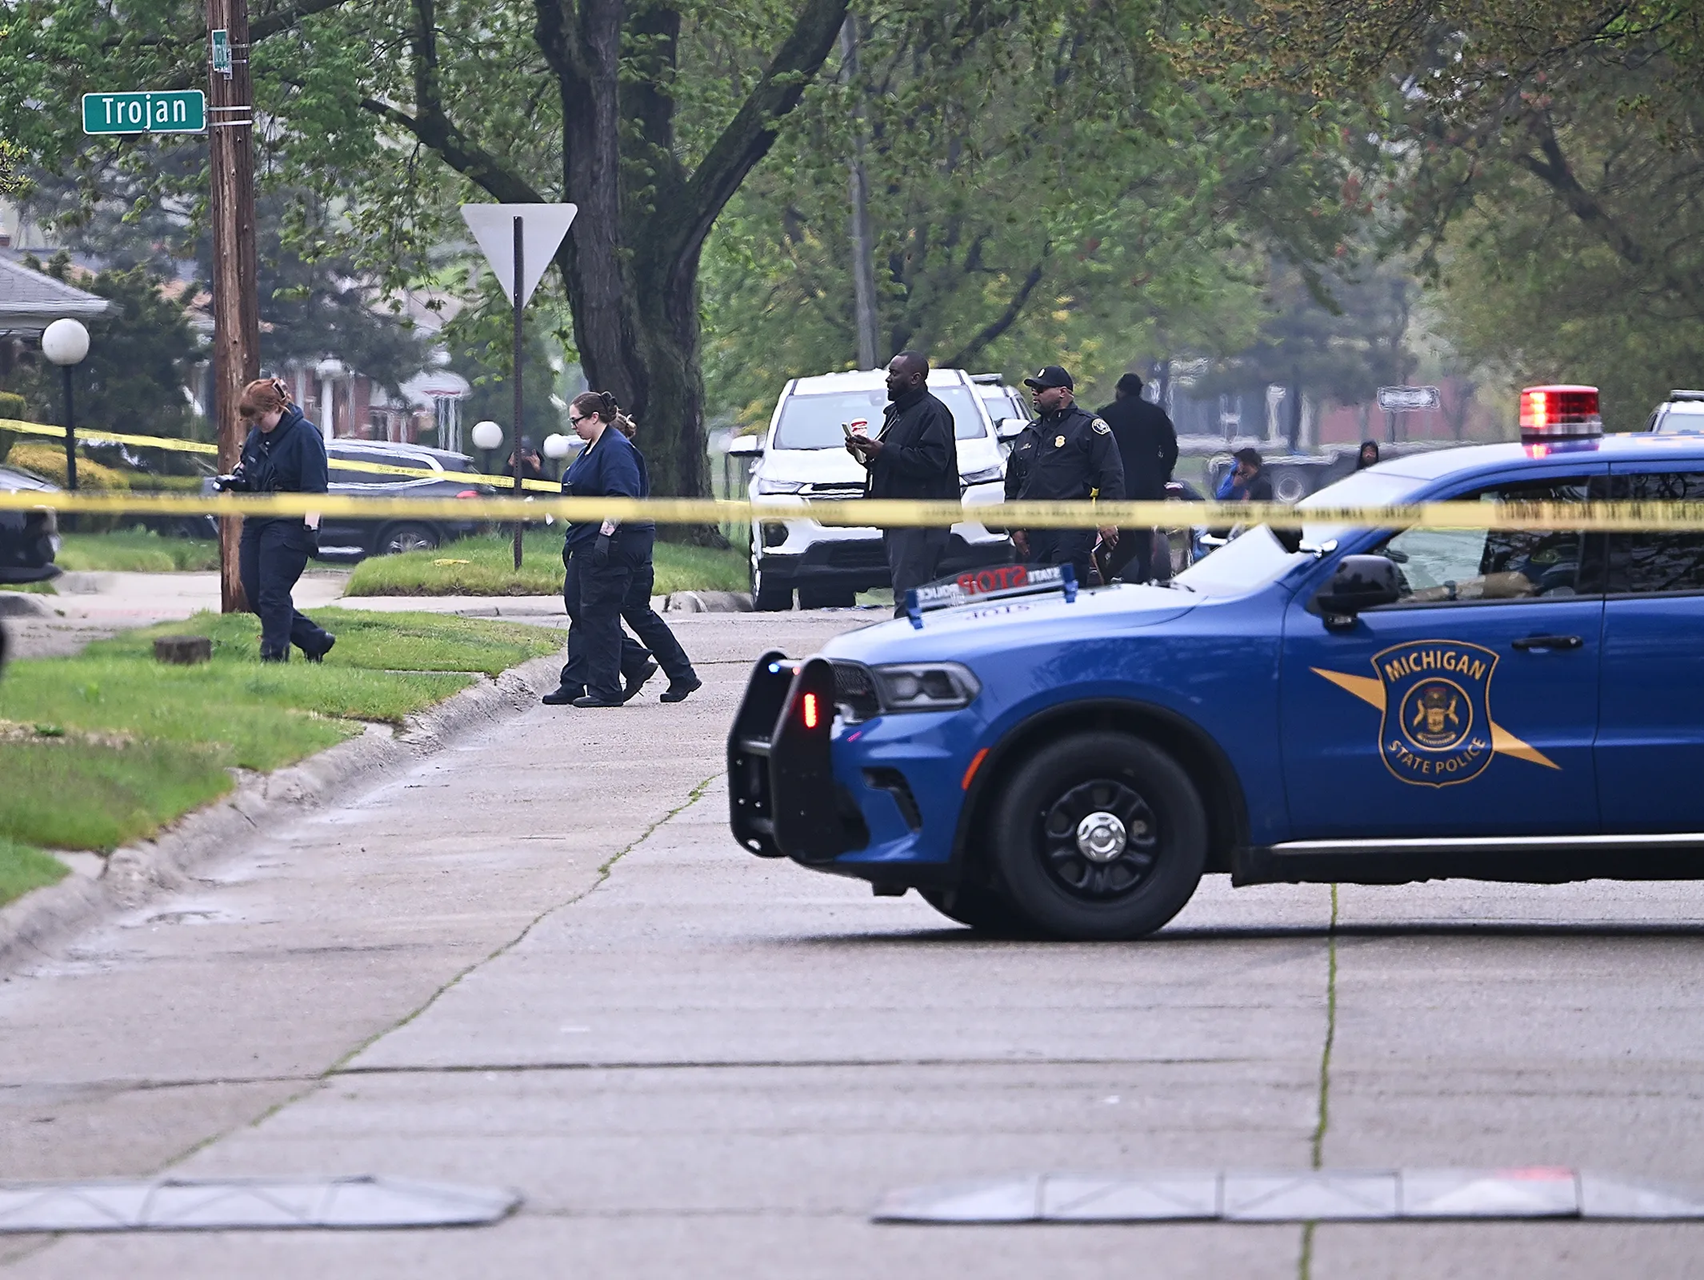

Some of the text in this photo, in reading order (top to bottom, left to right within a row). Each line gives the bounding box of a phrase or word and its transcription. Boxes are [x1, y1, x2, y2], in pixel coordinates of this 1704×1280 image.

[102, 94, 186, 130] Trojan
[1385, 650, 1486, 682] MICHIGAN
[1388, 737, 1486, 775] STATE POLICE
